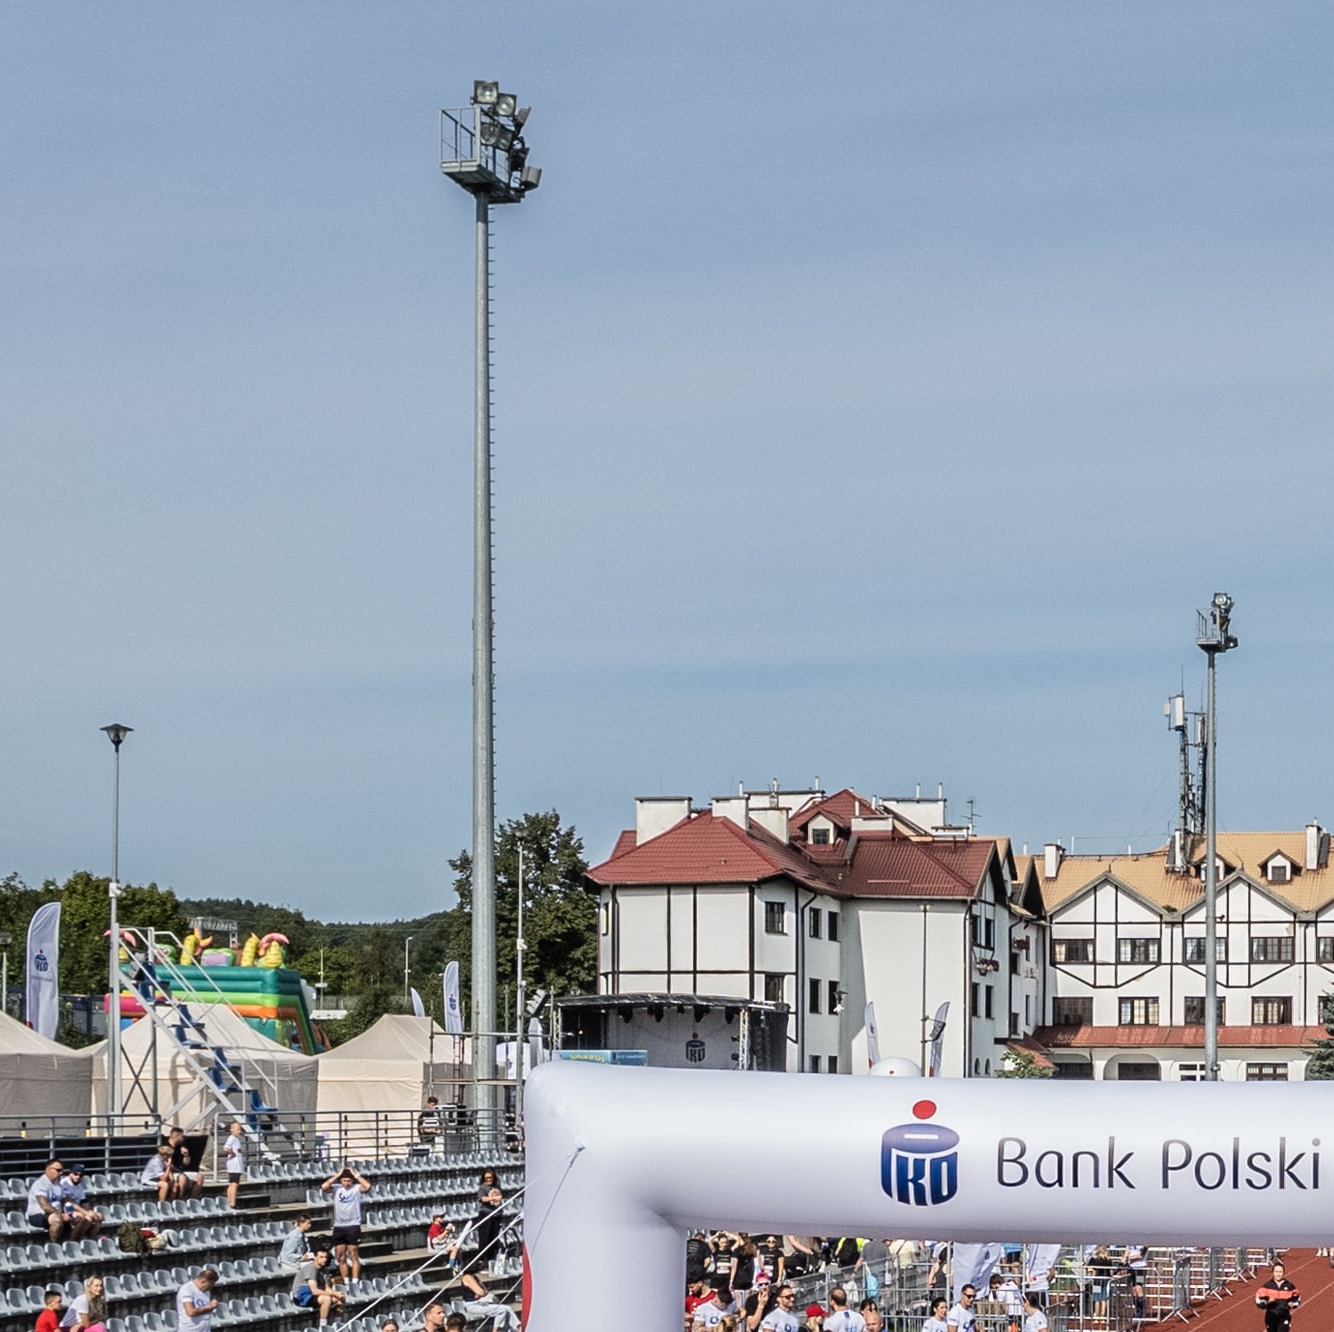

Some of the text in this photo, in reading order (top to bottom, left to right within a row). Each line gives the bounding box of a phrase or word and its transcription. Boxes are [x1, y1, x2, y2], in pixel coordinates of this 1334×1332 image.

[880, 1123, 1322, 1207] PKO Bank Polski
